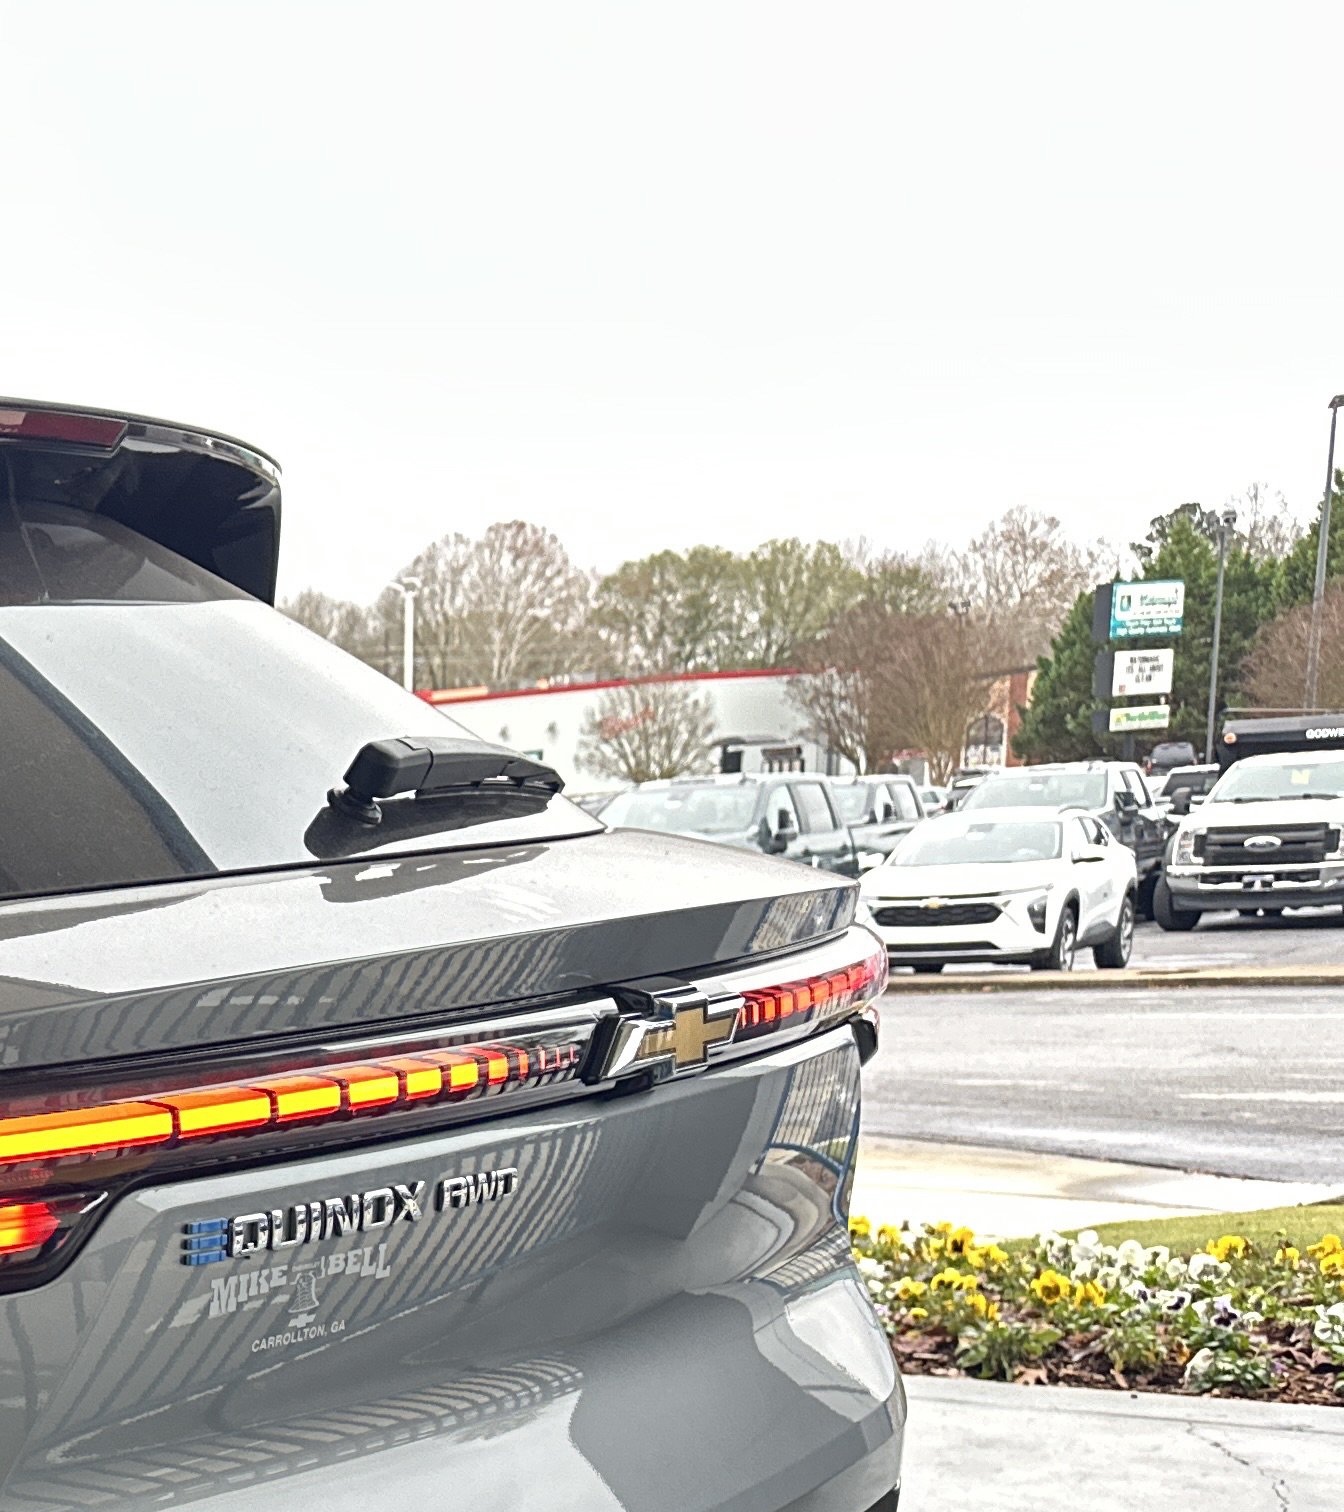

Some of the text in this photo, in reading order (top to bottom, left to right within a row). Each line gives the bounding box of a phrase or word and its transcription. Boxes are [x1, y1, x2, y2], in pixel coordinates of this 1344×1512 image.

[182, 1167, 519, 1266] EQUINOX AWD
[208, 1243, 391, 1319] MIKE BELL
[251, 1319, 346, 1353] CARROLLTON, GA
